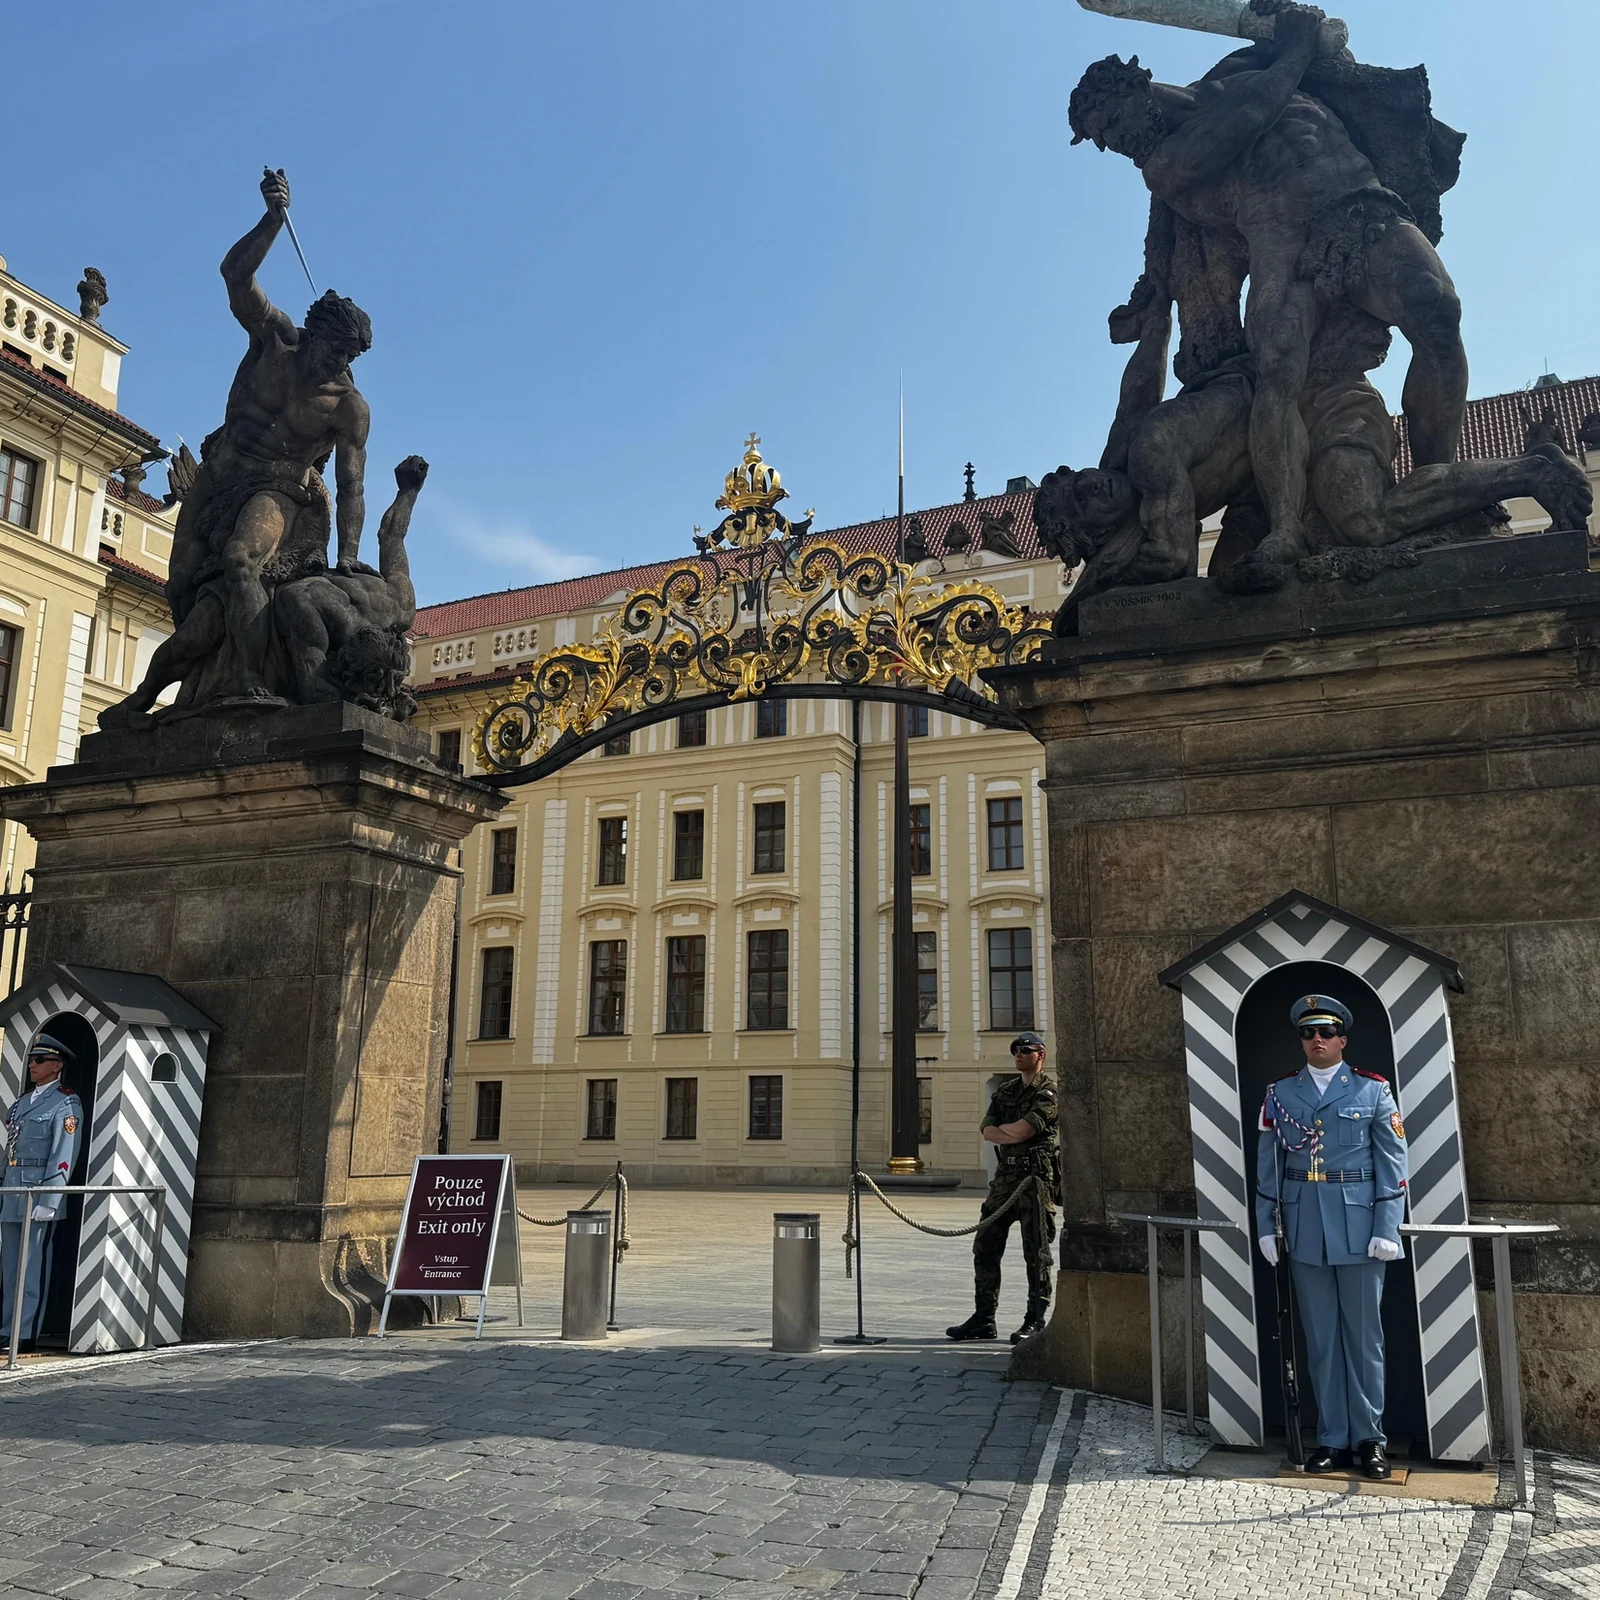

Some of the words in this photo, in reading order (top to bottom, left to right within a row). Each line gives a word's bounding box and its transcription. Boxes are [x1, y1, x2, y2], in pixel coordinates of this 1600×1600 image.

[434, 1176, 483, 1190] Pouze
[427, 1191, 486, 1211] východ
[417, 1219, 448, 1234] Exit
[451, 1218, 486, 1237] only
[434, 1255, 458, 1264] Vstup
[424, 1270, 462, 1278] Entrance
